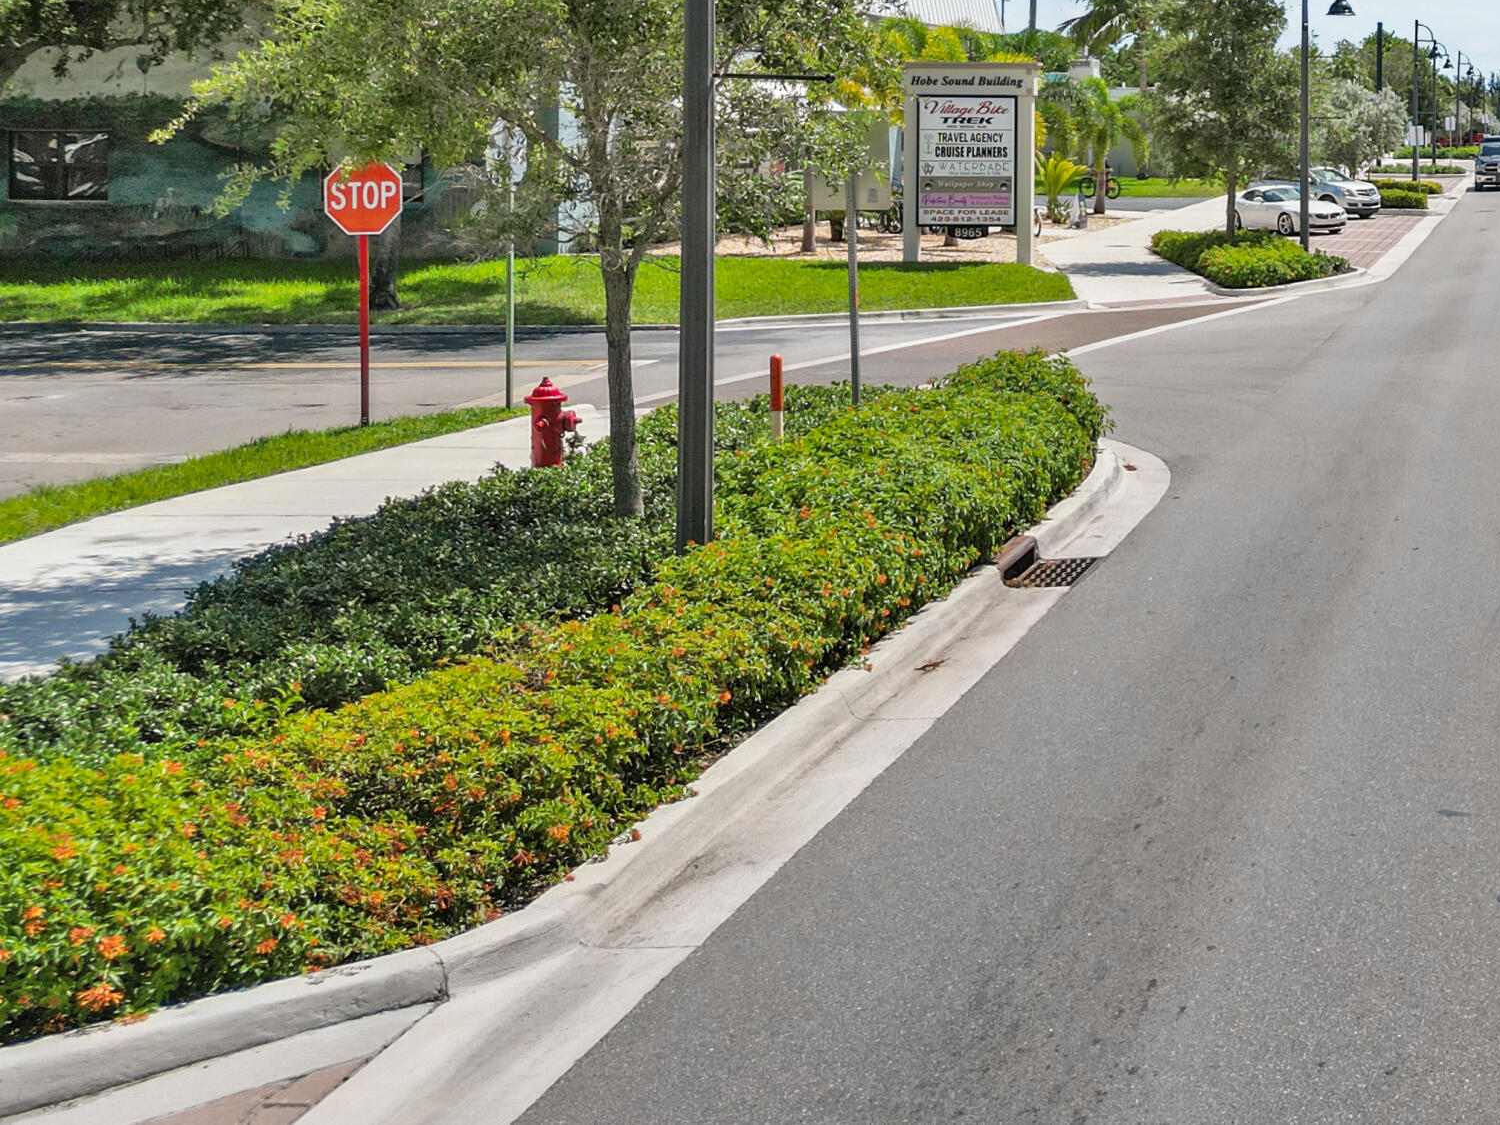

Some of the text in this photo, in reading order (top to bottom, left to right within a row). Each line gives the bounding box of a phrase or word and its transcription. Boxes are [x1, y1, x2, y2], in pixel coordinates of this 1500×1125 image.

[911, 76, 1023, 88] Hobe Sound Building
[924, 100, 1009, 117] Village Bike
[941, 116, 995, 124] TREK
[938, 133, 1003, 142] TRAVEL AGENCY
[935, 147, 1008, 157] CRUISE PLANNERS
[937, 180, 994, 189] Wallpaper Shop
[330, 181, 397, 210] STOP
[954, 228, 982, 237] 8965
